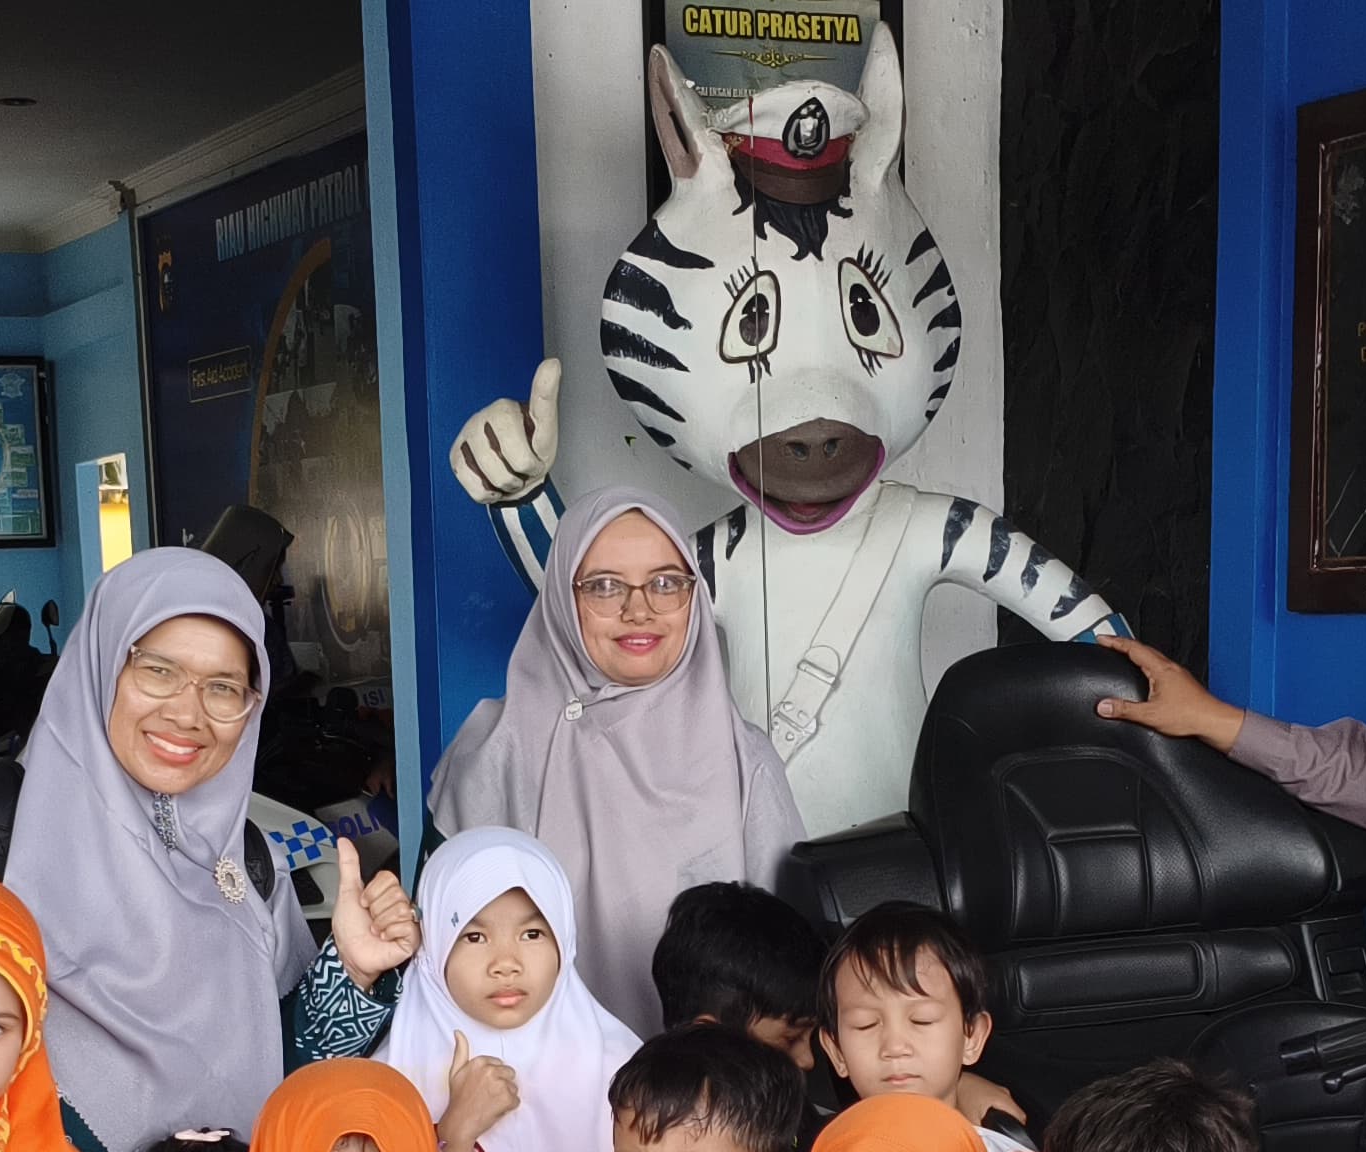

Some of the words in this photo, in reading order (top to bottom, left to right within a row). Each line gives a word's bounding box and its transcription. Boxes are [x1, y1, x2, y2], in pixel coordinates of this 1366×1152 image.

[684, 7, 752, 37] CATUR
[757, 12, 861, 42] PRASETYA
[215, 209, 246, 263] RIAU
[247, 184, 307, 252] HIGHWAY
[308, 164, 362, 230] PATROL
